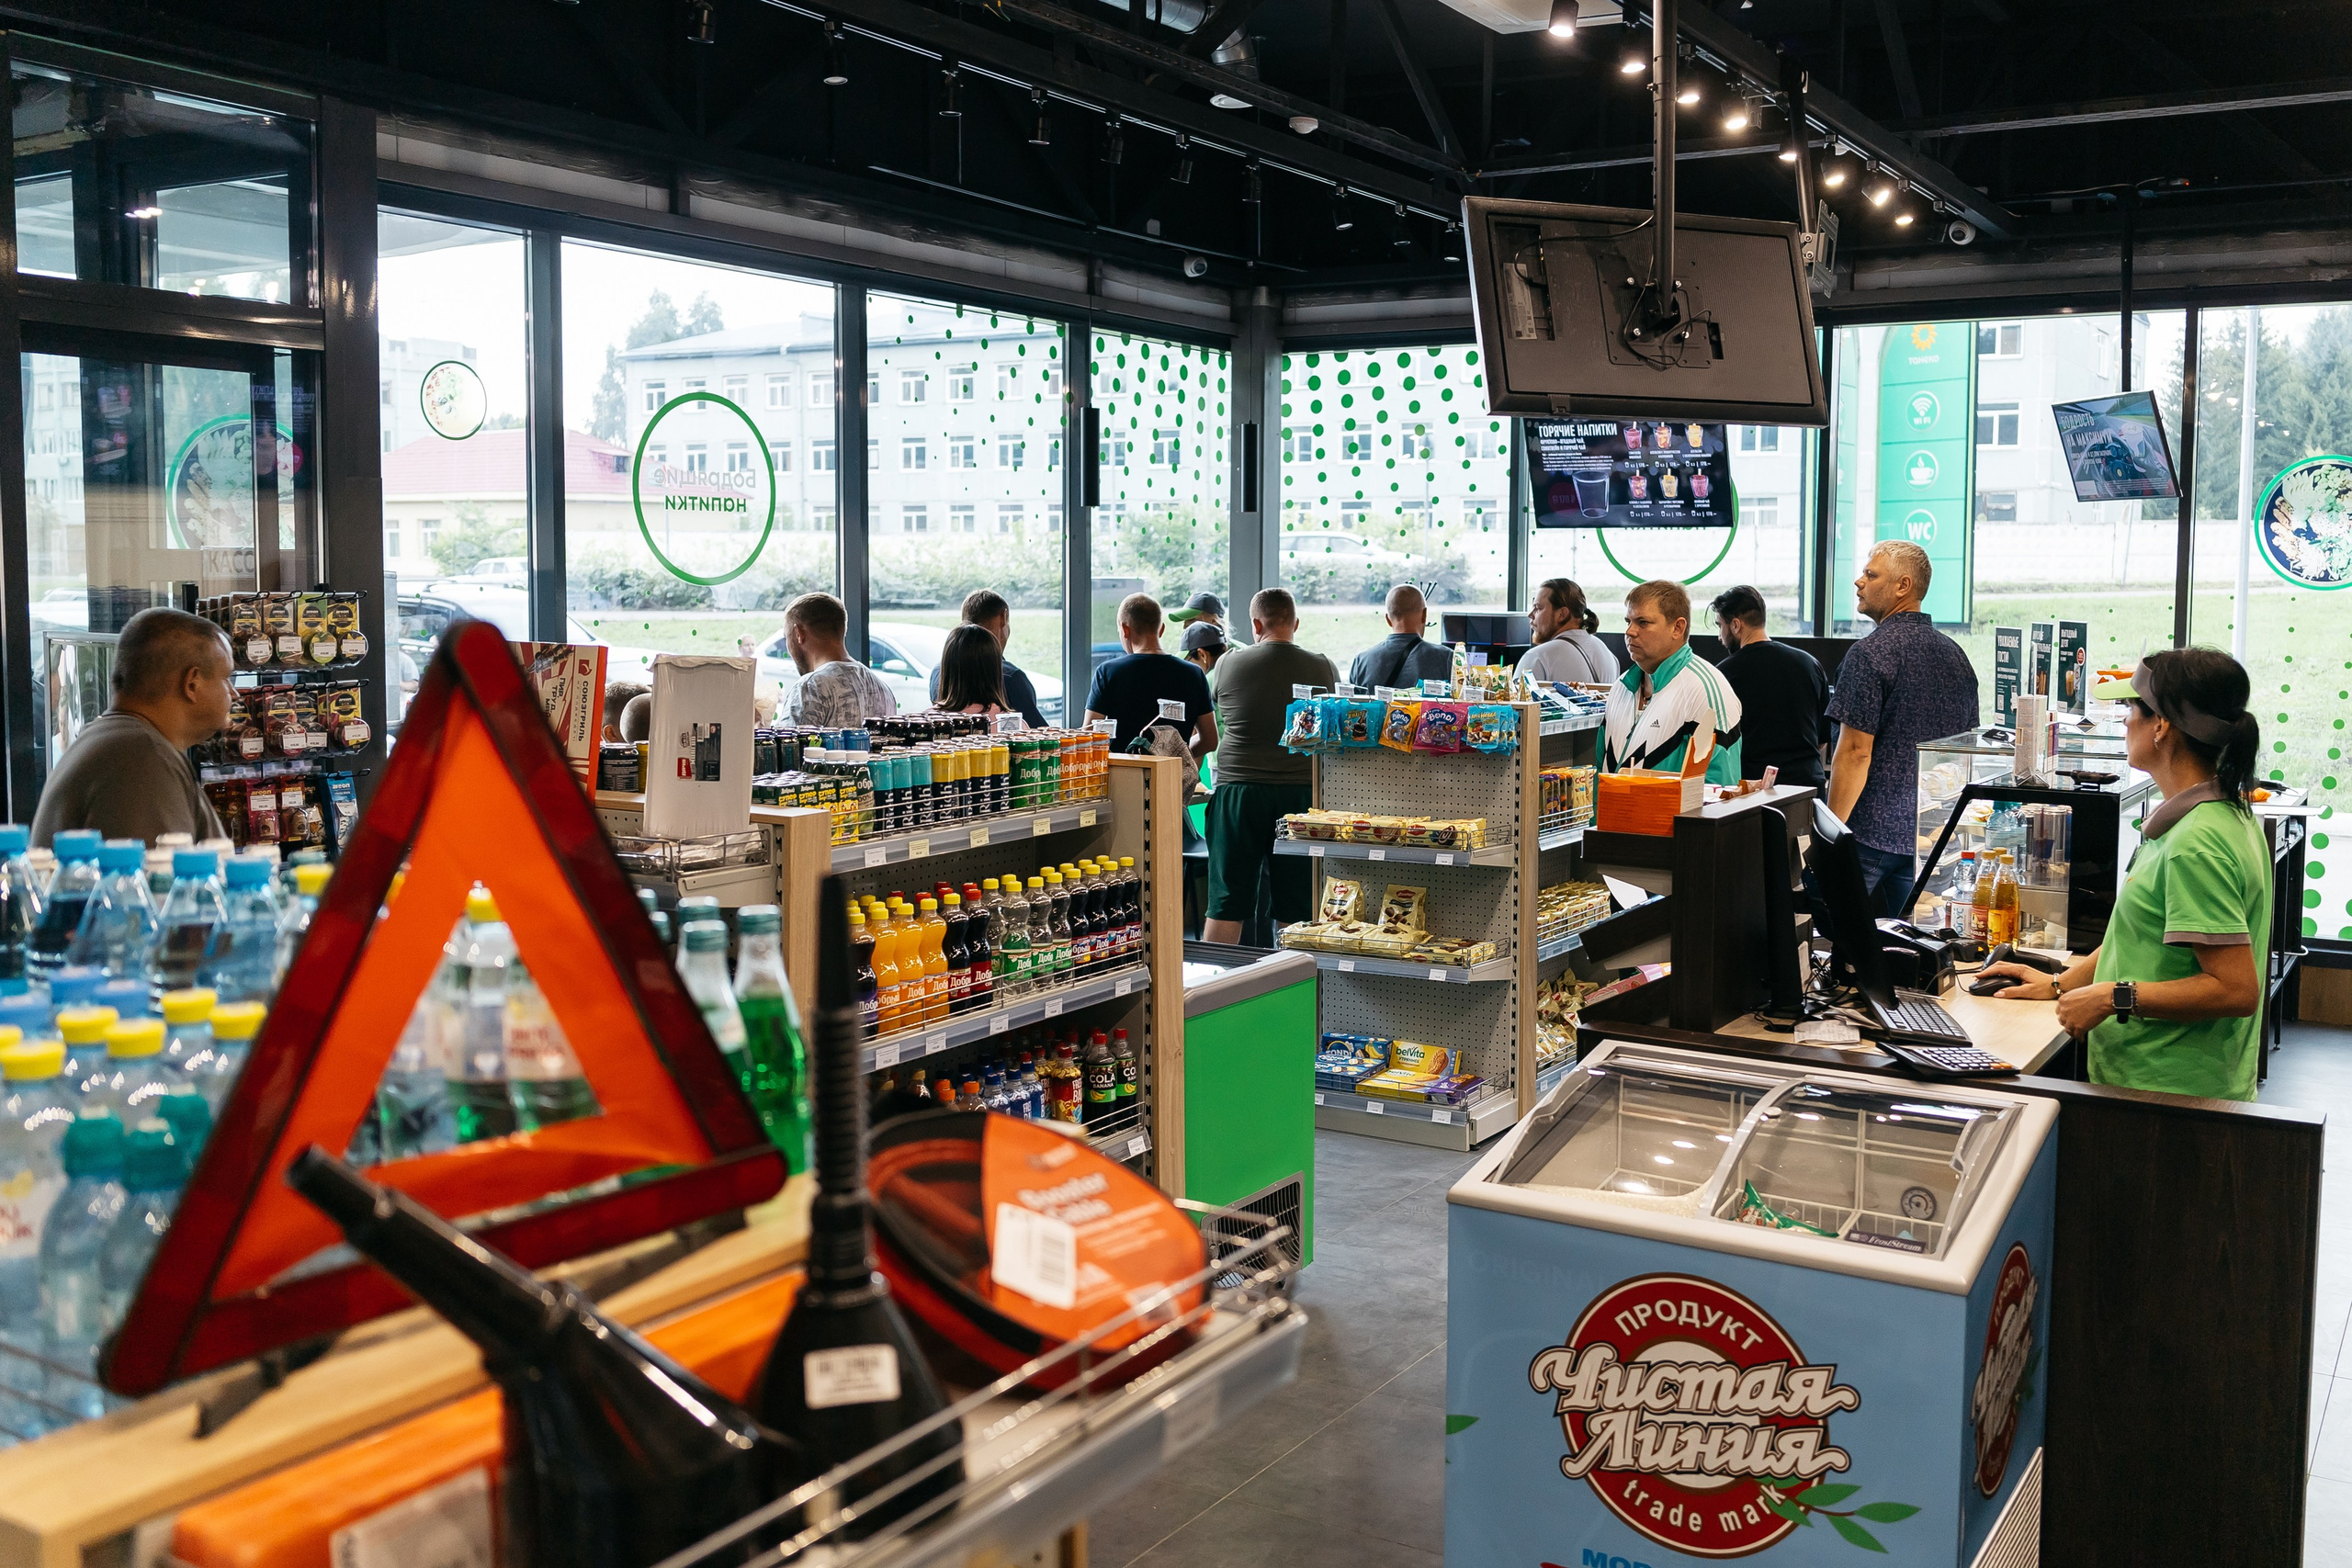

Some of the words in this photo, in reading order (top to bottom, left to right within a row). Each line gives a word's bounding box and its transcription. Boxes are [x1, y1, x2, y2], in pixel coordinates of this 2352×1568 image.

[1539, 425, 1576, 437] ГОРЯЧИЕ
[1577, 423, 1617, 436] НАПИТКИ
[2061, 412, 2095, 429] БОДРОСТЬ
[2076, 430, 2112, 446] МАКСИМУМ
[1907, 522, 1931, 540] WC
[558, 678, 566, 698] ПИР,
[578, 681, 588, 741] СОЮЗГРИЛЬ
[1046, 765, 1060, 777] Доб
[902, 791, 914, 826] Rich
[919, 787, 932, 823] Rich
[940, 784, 952, 820] Rich
[979, 779, 990, 813] Rich
[1001, 777, 1009, 810] Rich
[885, 792, 895, 829] Rich
[1396, 1046, 1425, 1058] belVita
[1090, 1074, 1115, 1084] COLA
[1123, 1066, 1136, 1077] CO
[1868, 1235, 1922, 1252] FrostStream
[1614, 1299, 1763, 1350] ПРОДУКТ
[1529, 1340, 1860, 1419] Чистая
[1560, 1407, 1851, 1480] Линия
[1623, 1479, 1702, 1532] trade
[1719, 1483, 1787, 1532] mark
